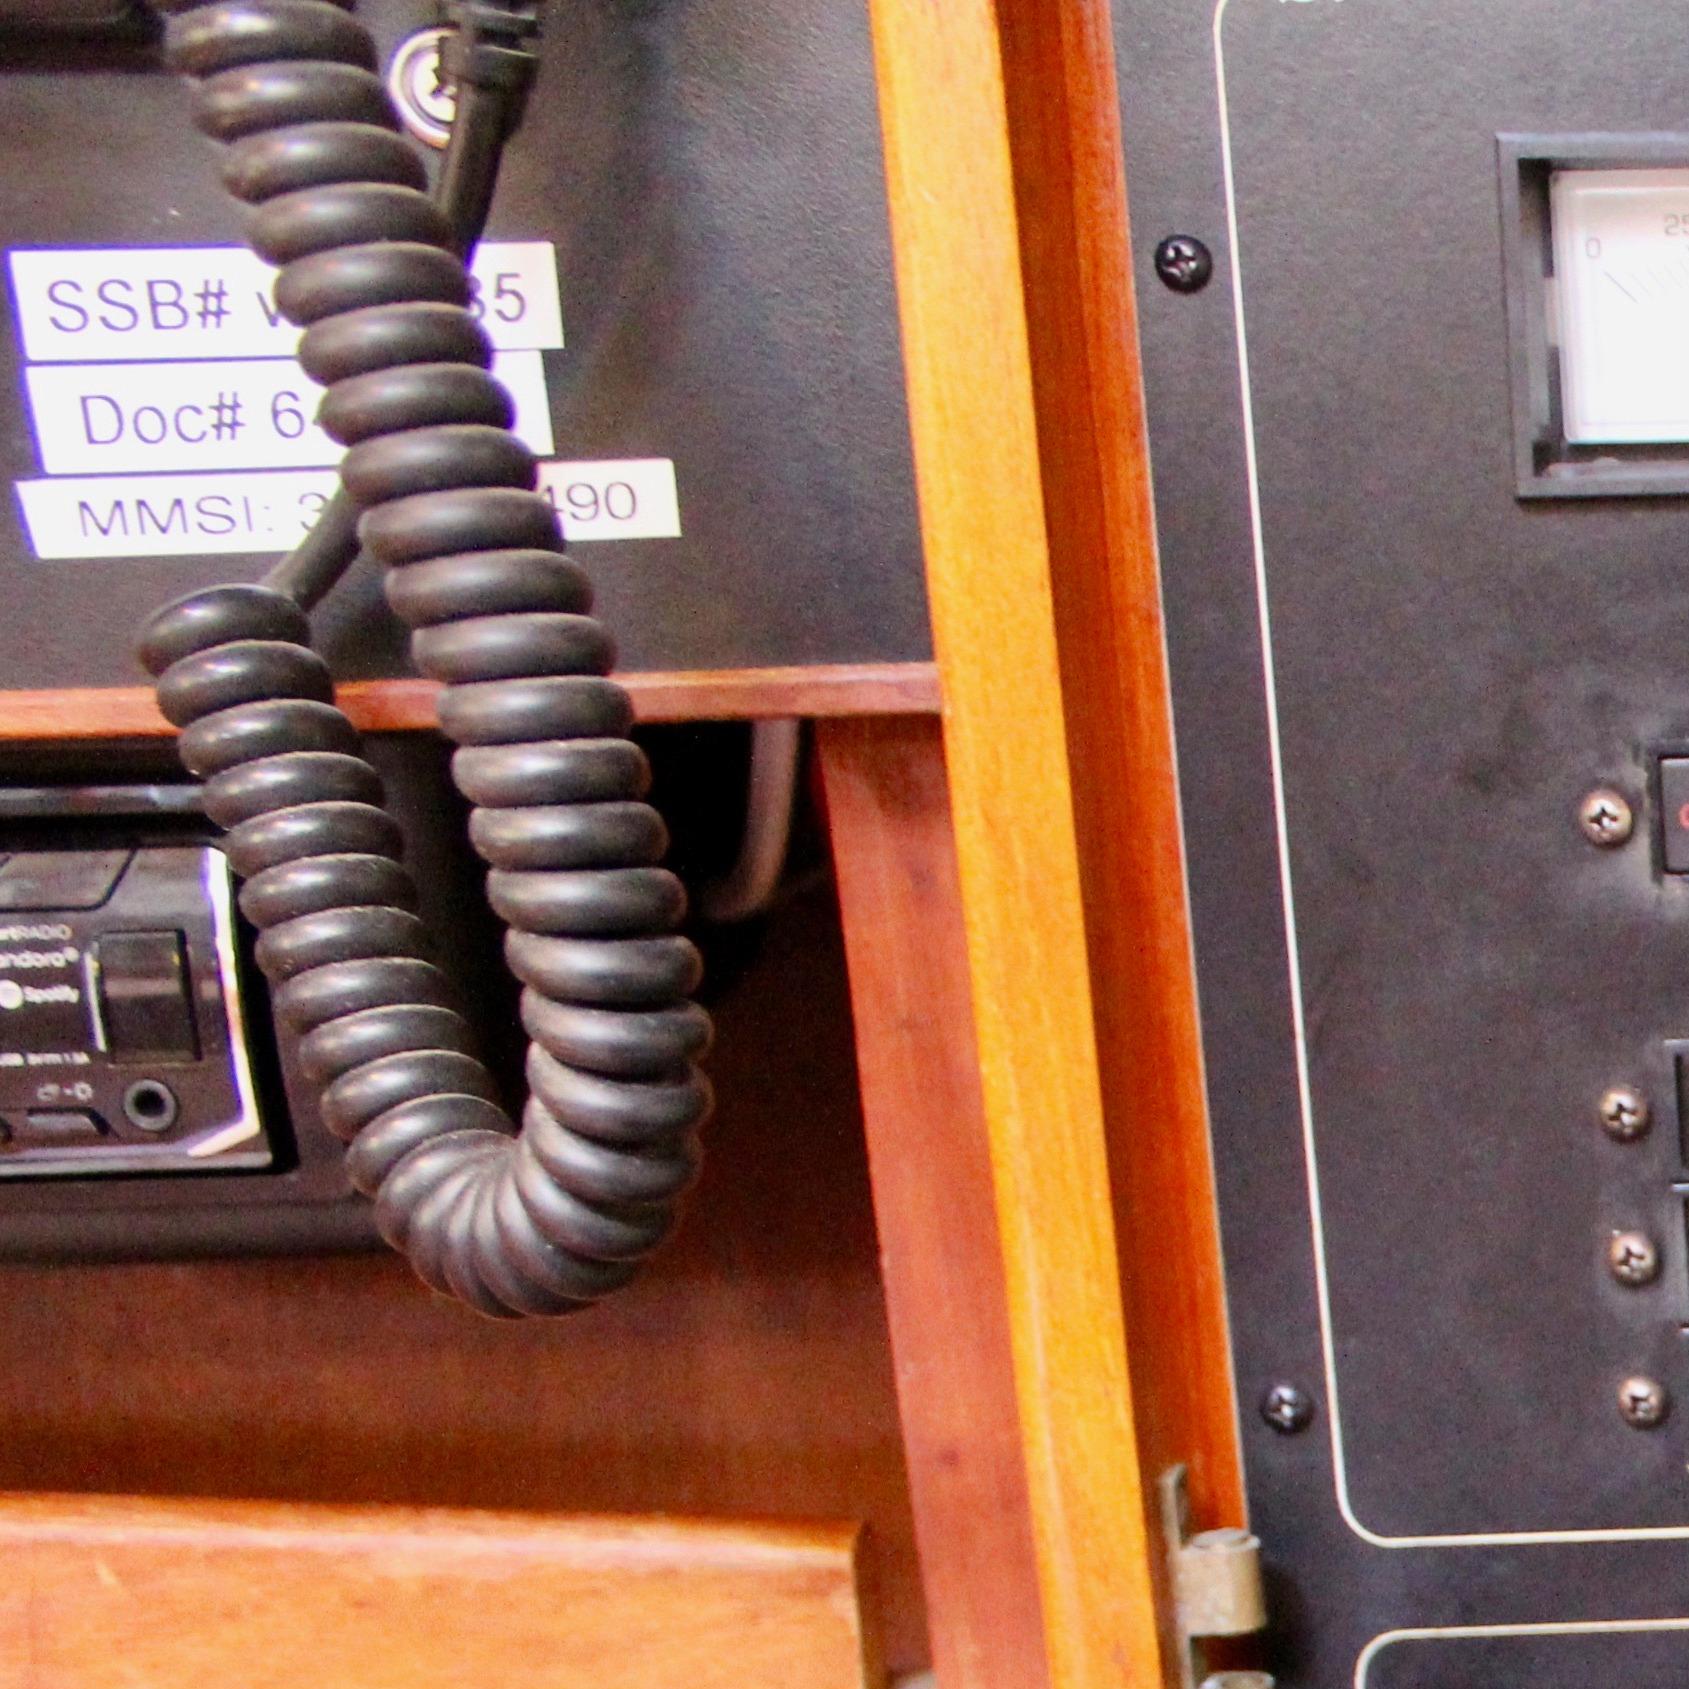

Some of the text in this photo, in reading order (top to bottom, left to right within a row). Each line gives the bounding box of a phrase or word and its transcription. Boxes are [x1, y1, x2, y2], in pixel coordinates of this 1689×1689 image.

[47, 278, 231, 333] SSB#
[80, 391, 246, 445] Doc#
[78, 495, 274, 537] MMSI:
